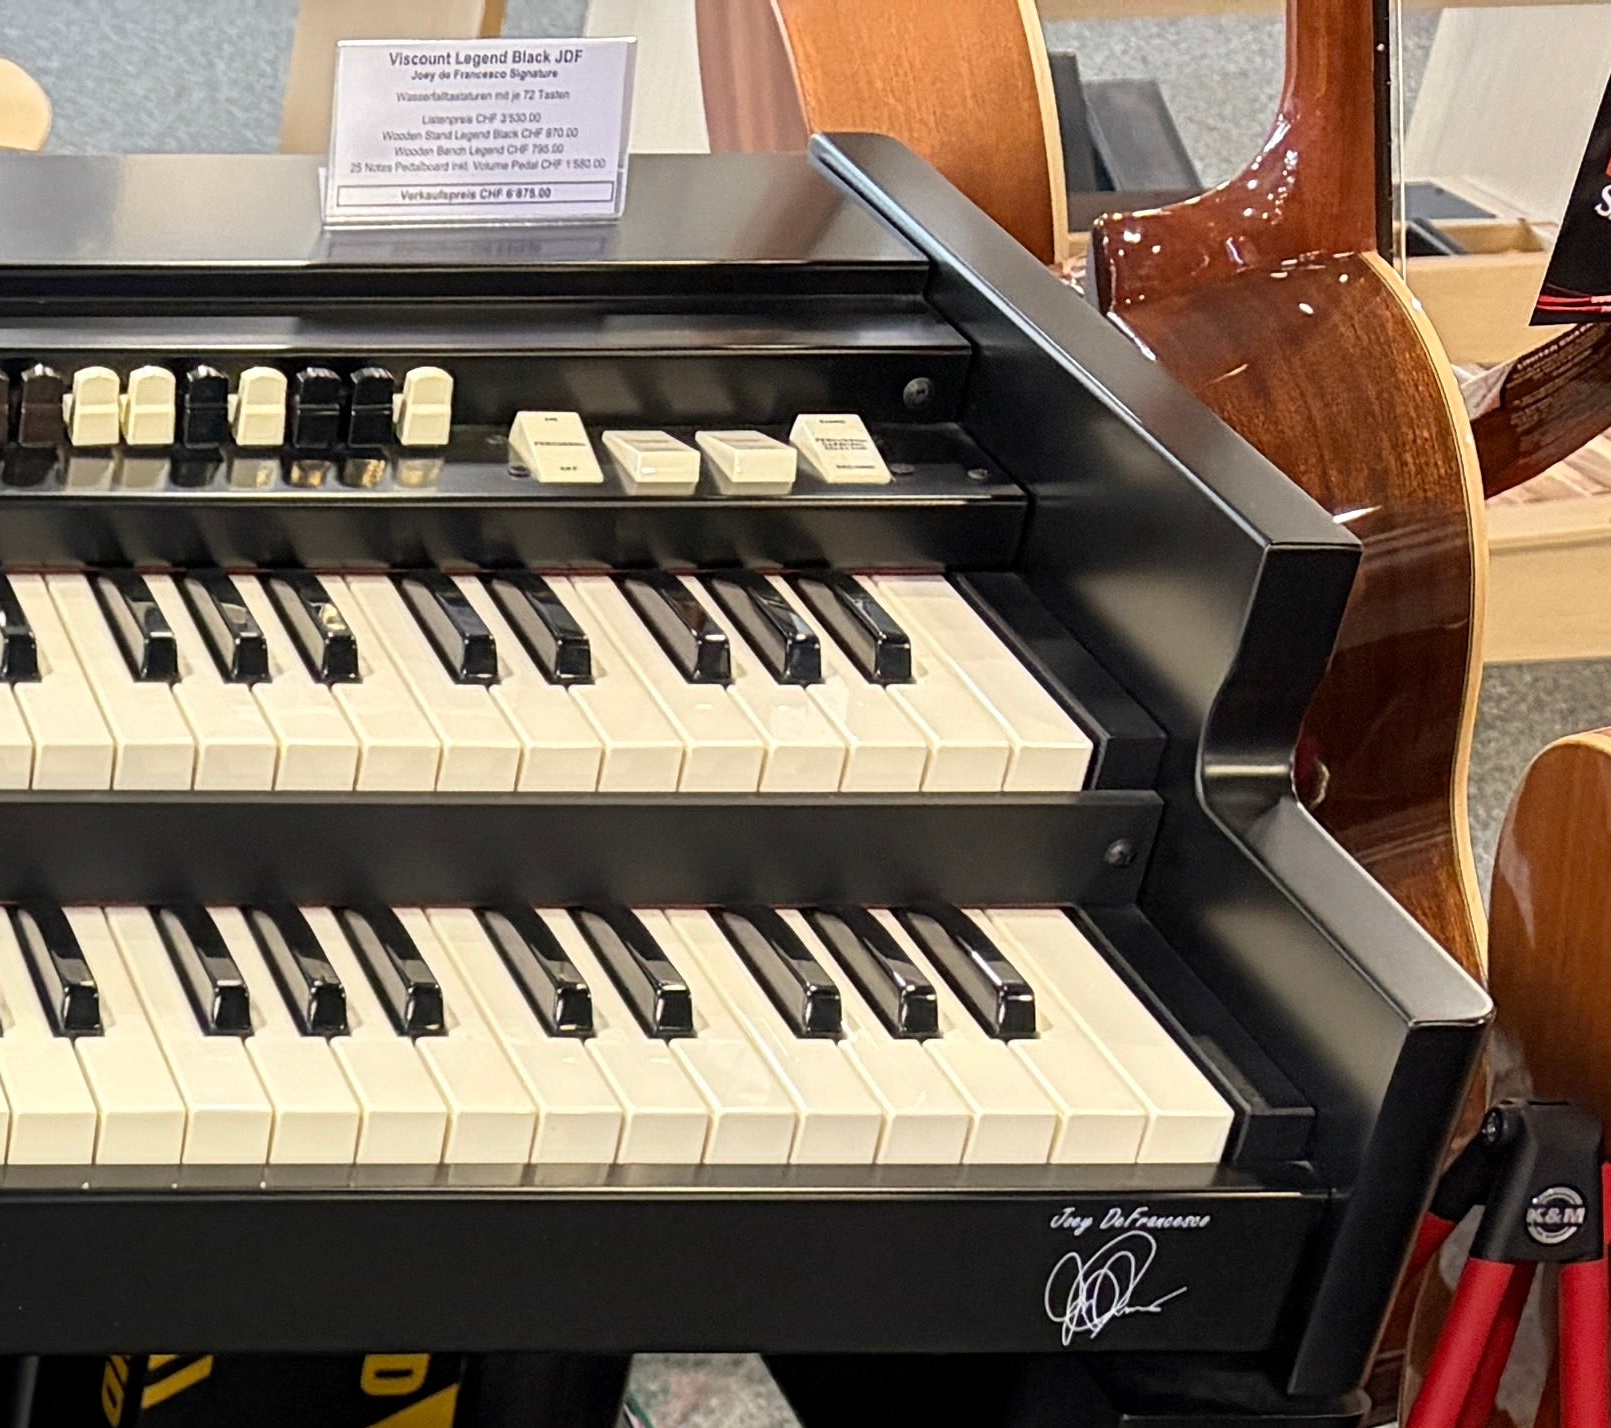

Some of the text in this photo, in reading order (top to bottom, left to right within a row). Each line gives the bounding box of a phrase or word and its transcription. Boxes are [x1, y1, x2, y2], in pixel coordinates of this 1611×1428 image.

[389, 49, 584, 68] Viscount Legend Black JDF
[411, 71, 435, 82] Joey
[453, 69, 507, 79] Francesco
[510, 68, 558, 81] Signature
[523, 90, 535, 100] 72
[538, 88, 570, 100] Tasten
[493, 128, 519, 139] Black
[521, 128, 544, 139] CHF
[507, 143, 530, 155] CHF
[511, 159, 539, 170] Pedal
[540, 158, 564, 170] CHF
[400, 189, 476, 202] Verkaufspreis
[479, 188, 501, 200] CHF
[1050, 1207, 1094, 1237] Joey
[1526, 1207, 1586, 1225] K&M
